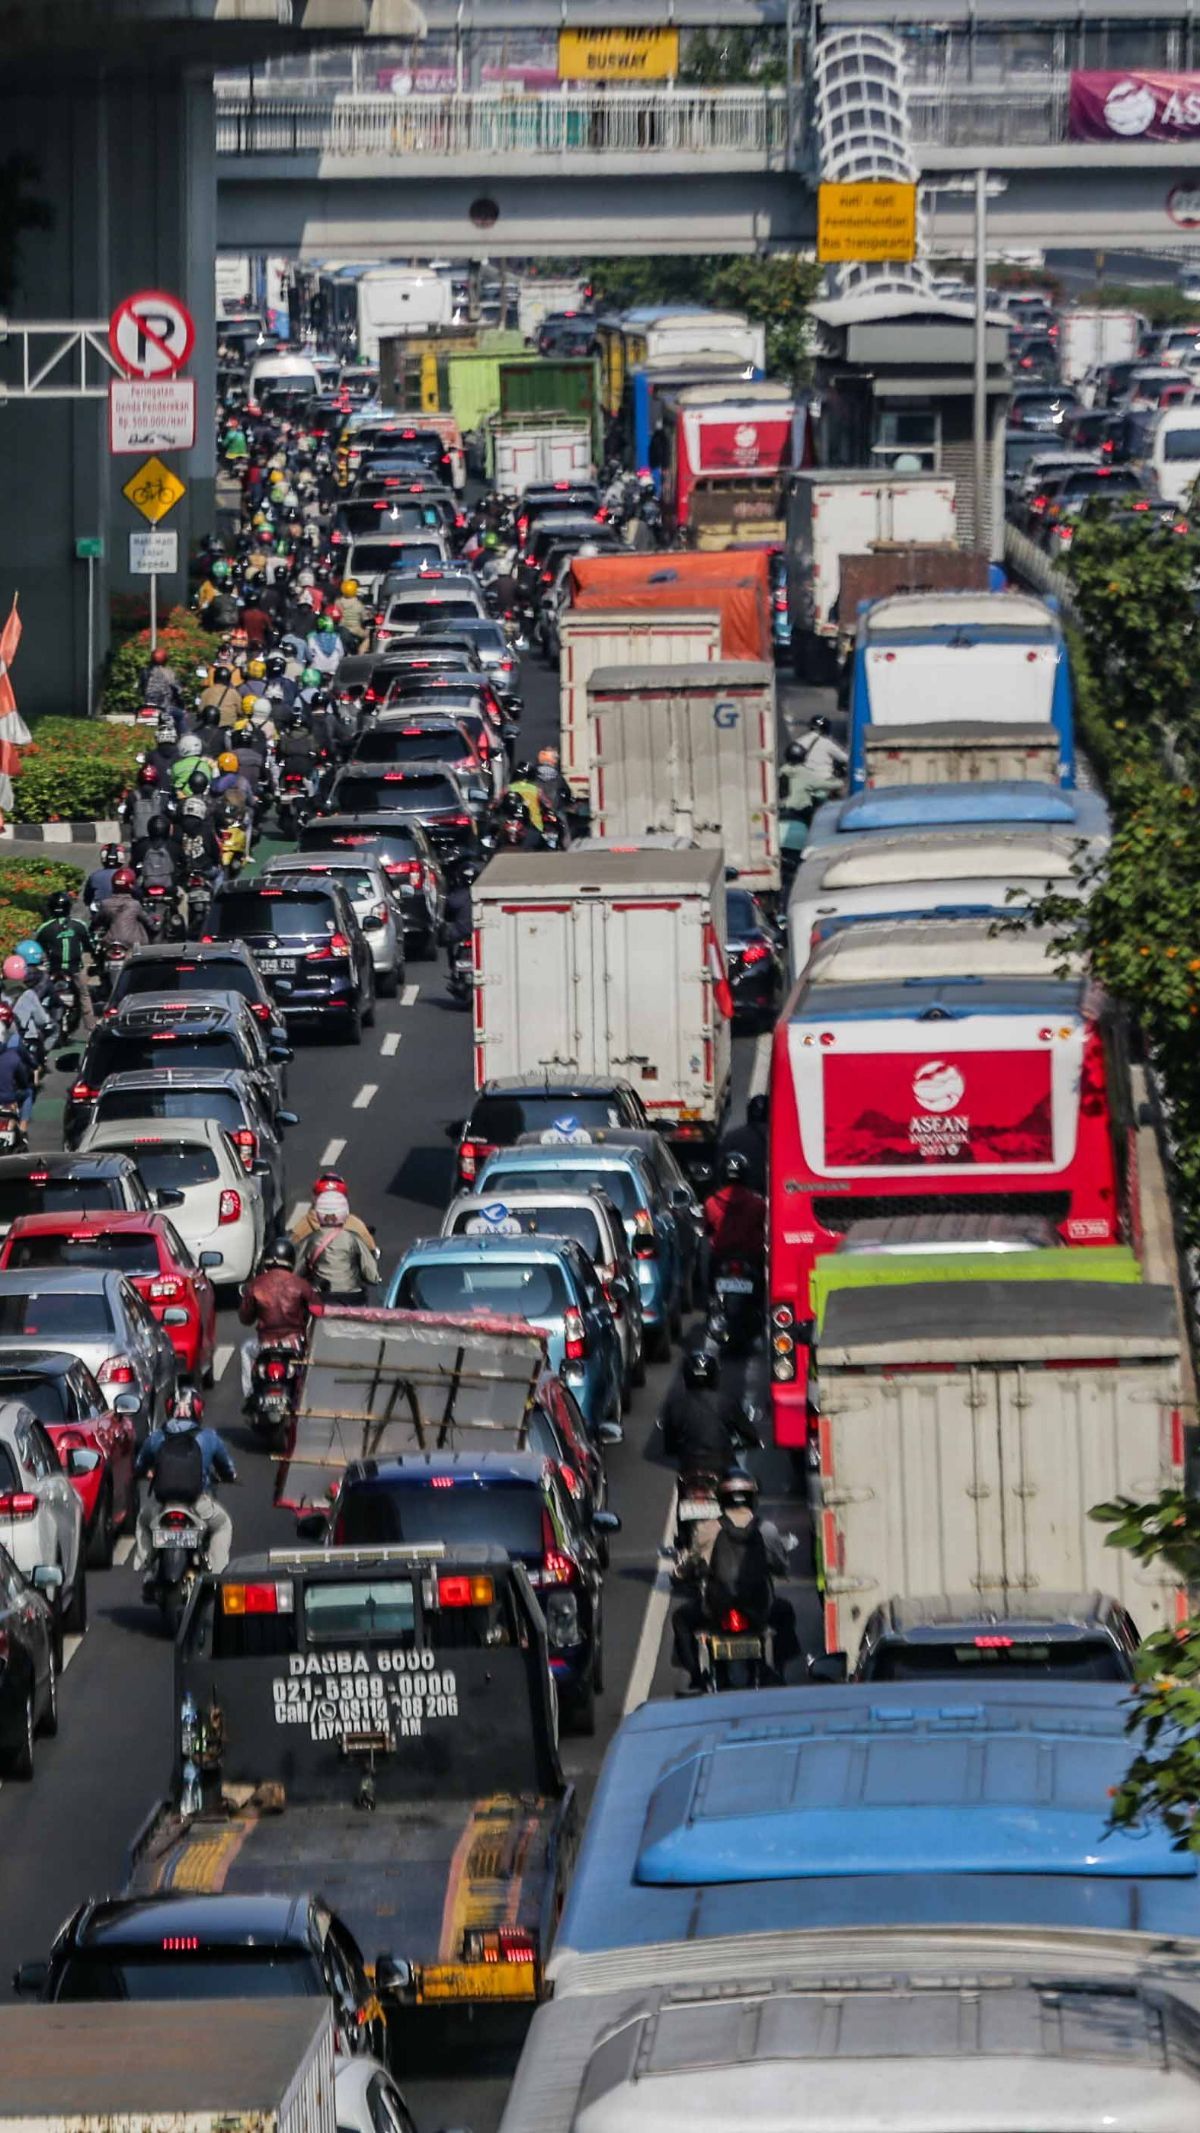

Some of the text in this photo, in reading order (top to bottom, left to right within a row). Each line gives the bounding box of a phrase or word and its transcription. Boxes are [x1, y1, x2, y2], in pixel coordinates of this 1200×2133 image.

[587, 51, 648, 70] BUSWAY
[131, 385, 175, 399] Peringatan
[143, 400, 189, 412] Penderekan
[714, 703, 739, 729] G
[909, 1115, 969, 1132] ASEAN
[909, 1132, 970, 1144] INDONESIA
[377, 1648, 435, 1673] 6000
[396, 1716, 422, 1737] AM
